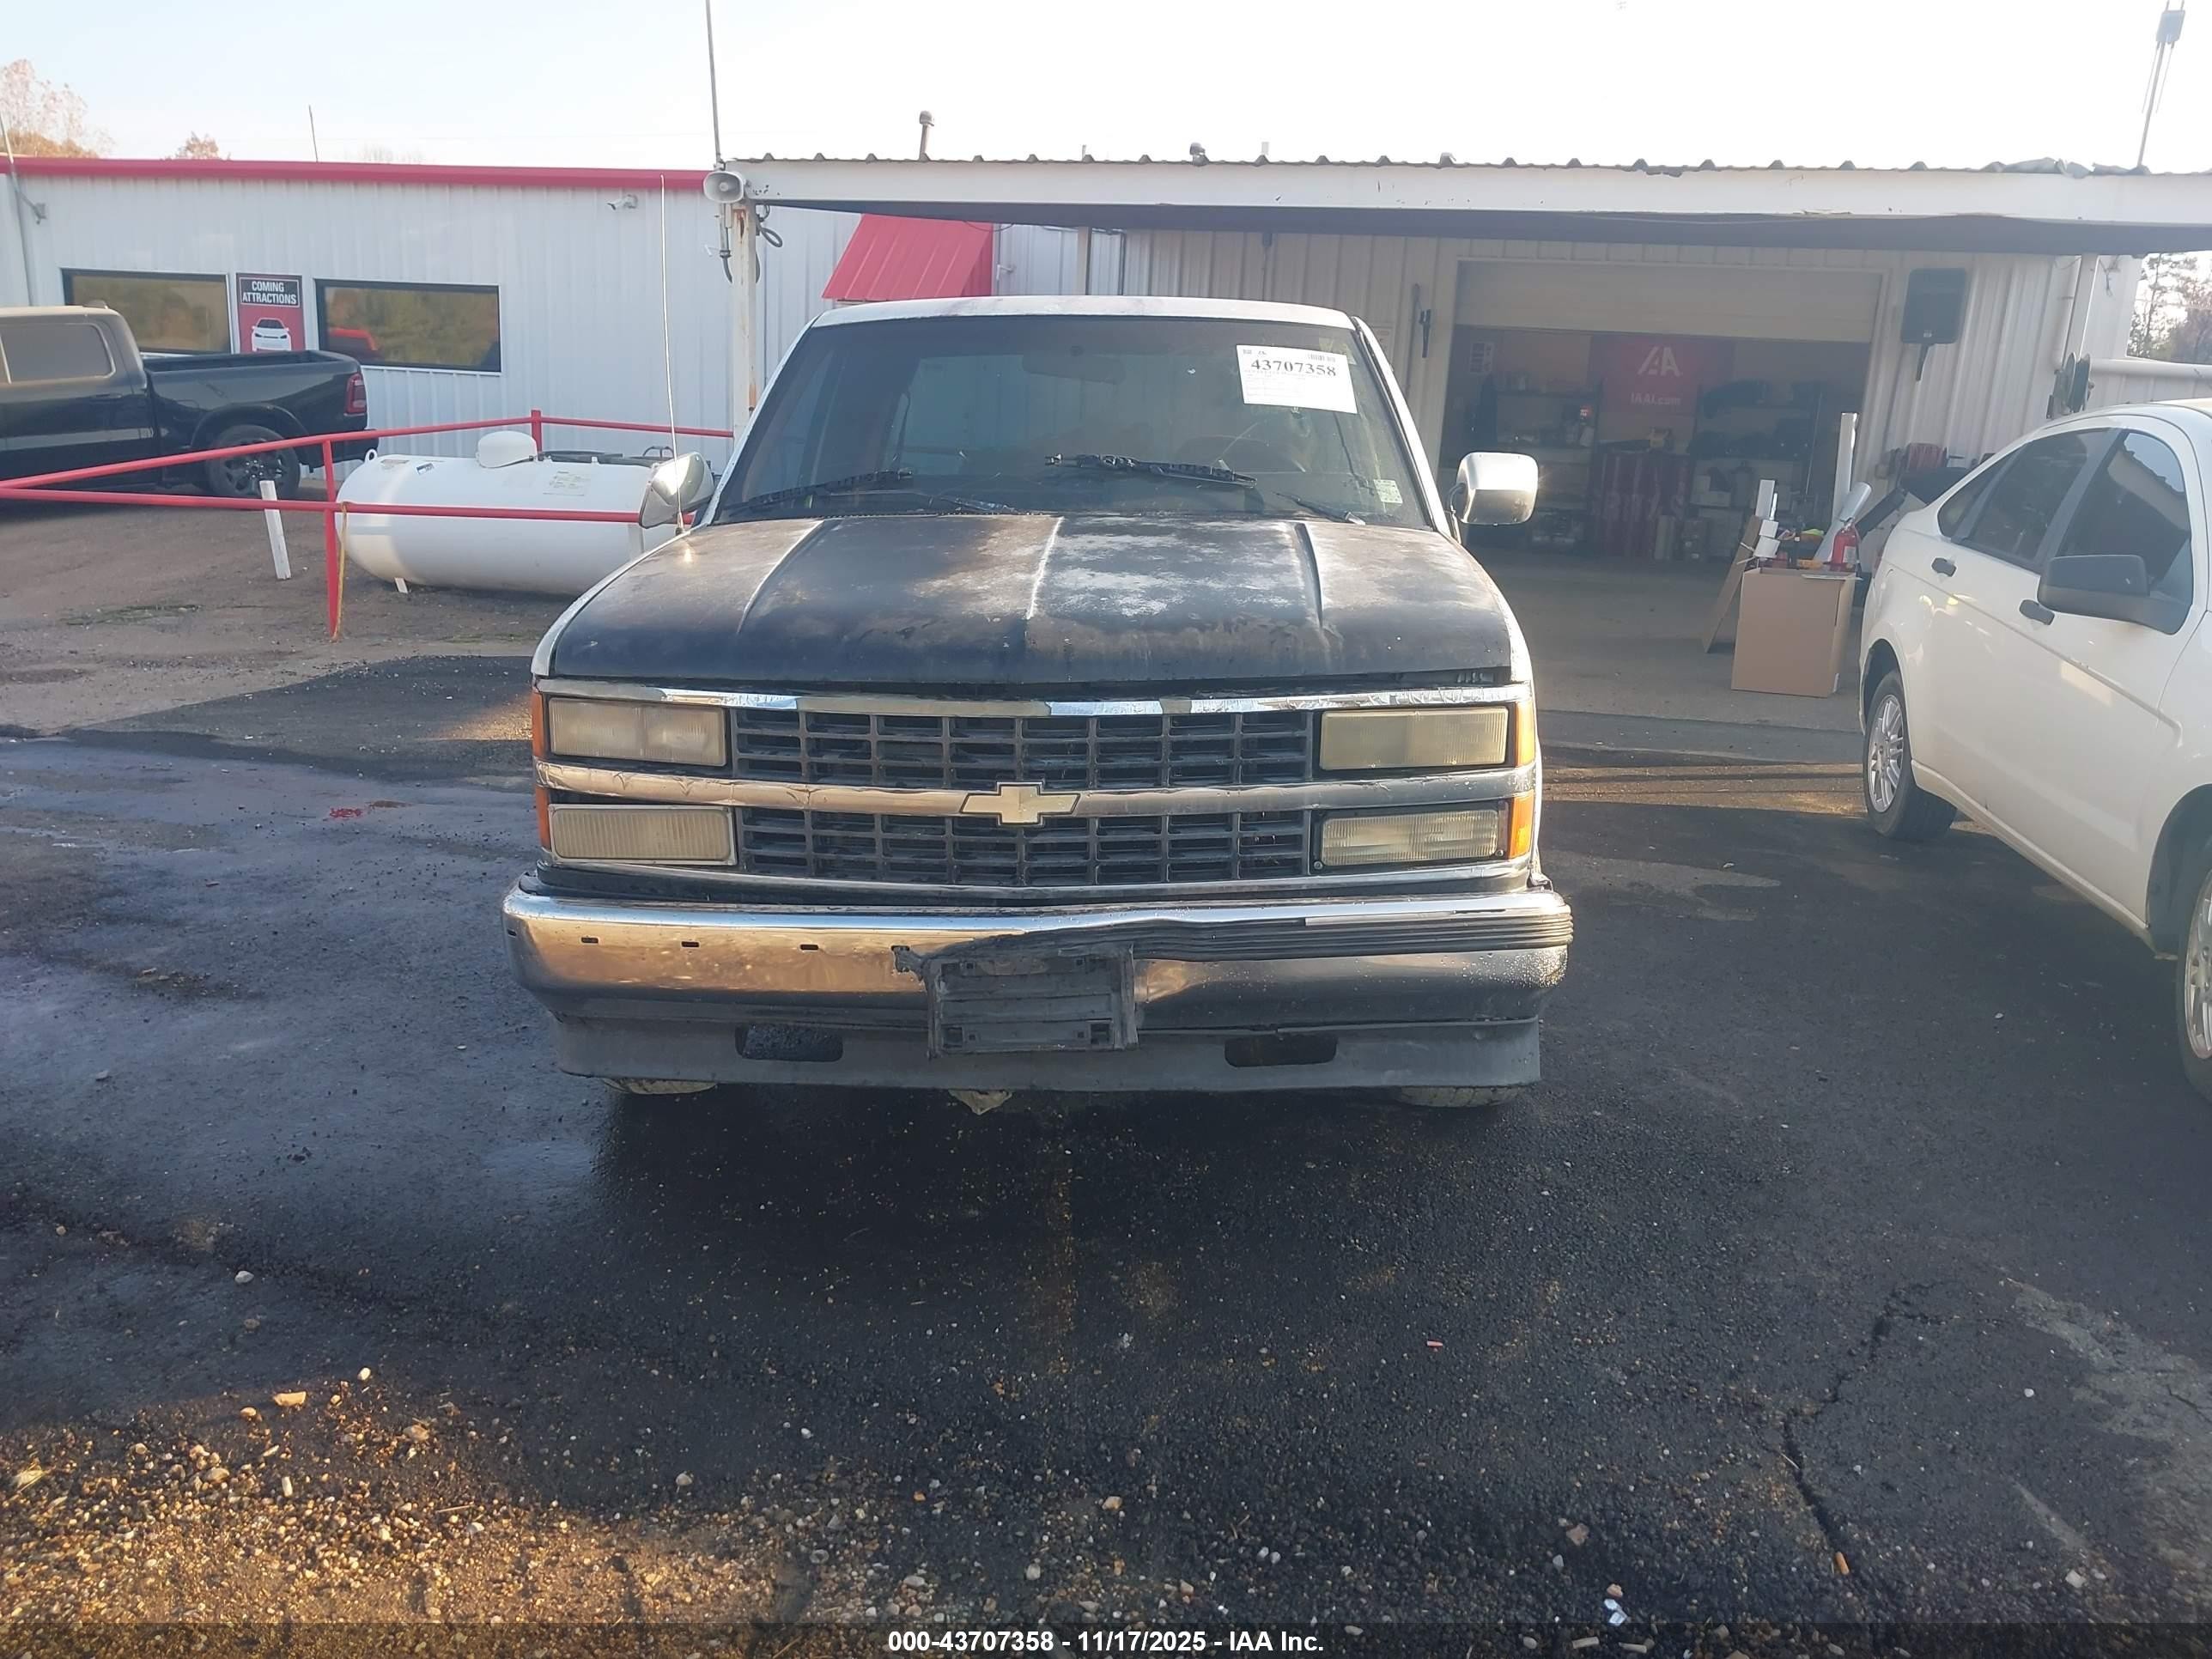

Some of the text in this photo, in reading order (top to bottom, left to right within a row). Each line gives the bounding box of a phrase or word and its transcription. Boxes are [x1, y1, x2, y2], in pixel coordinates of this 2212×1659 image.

[252, 281, 284, 293] COMING
[242, 292, 296, 305] ATTRACTIONS
[1250, 358, 1336, 377] 43707358
